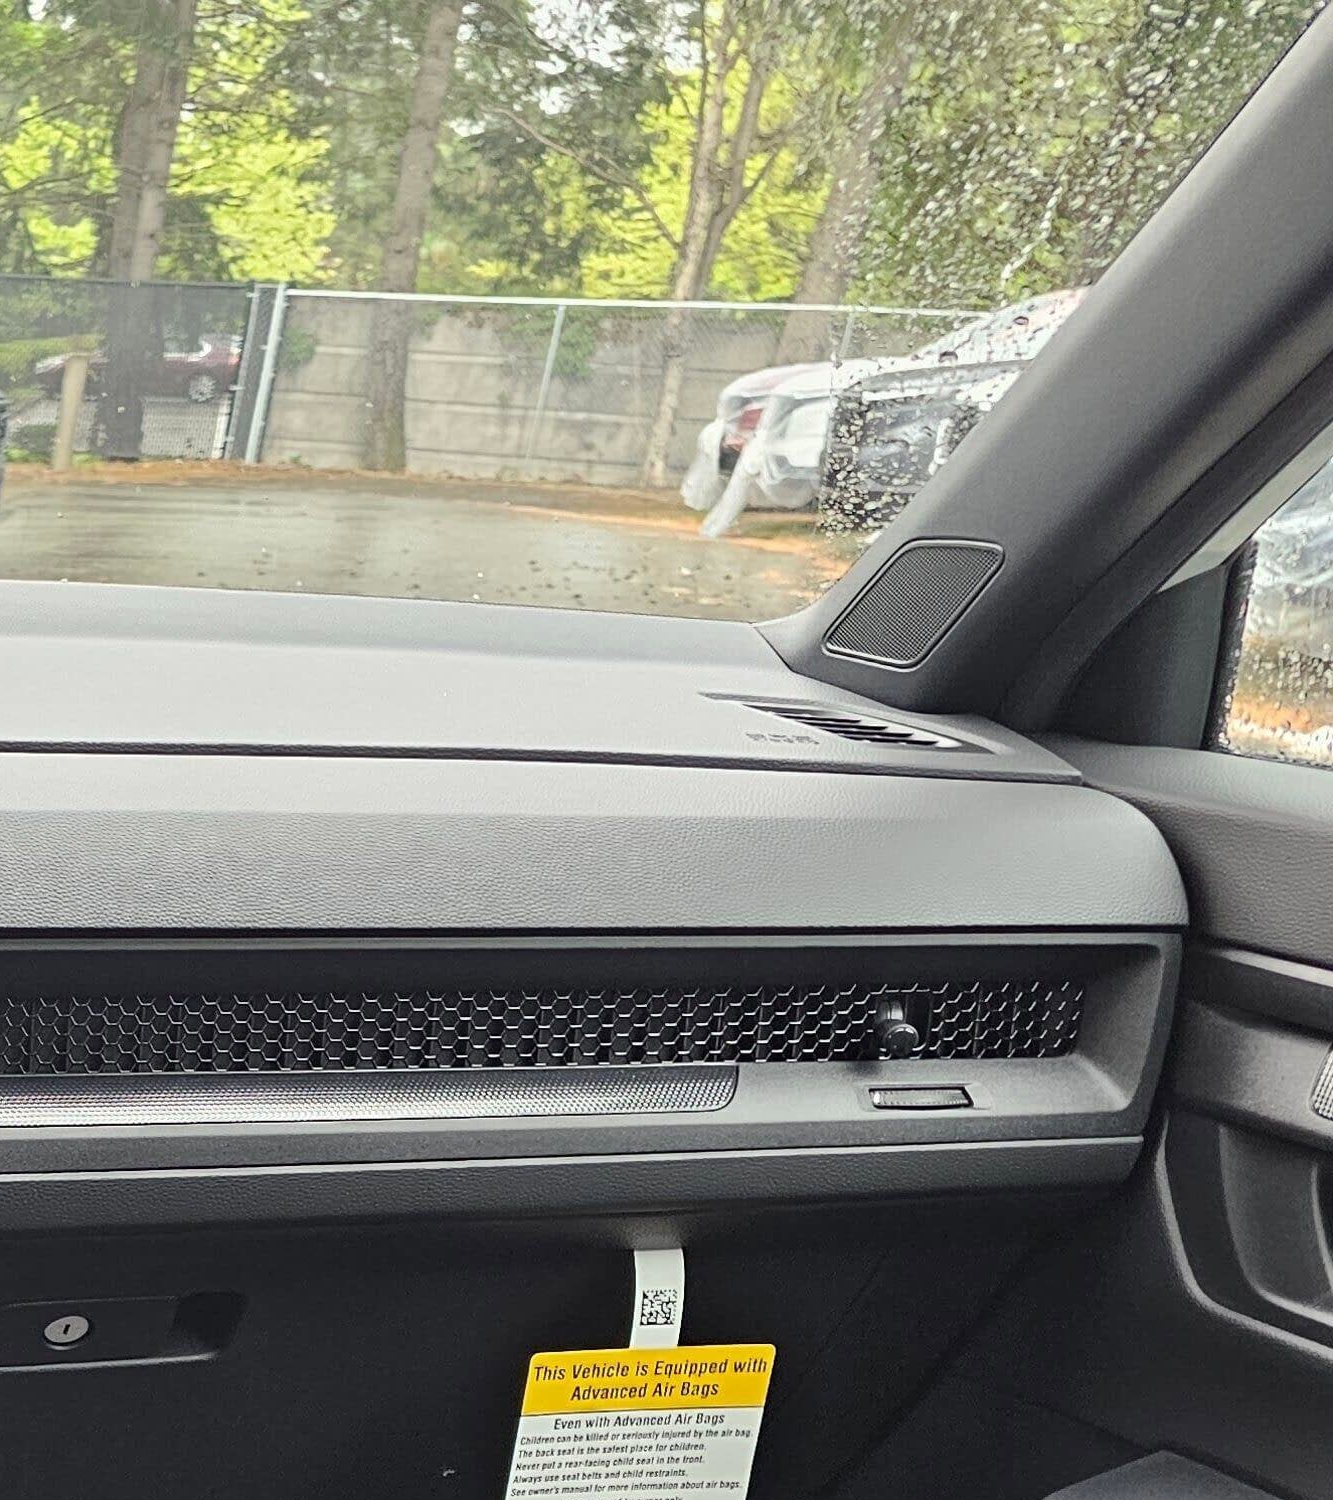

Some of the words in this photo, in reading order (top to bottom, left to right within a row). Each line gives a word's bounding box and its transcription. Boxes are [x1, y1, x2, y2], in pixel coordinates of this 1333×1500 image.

[534, 1366, 566, 1381] This
[572, 1362, 629, 1379] Vehicle
[635, 1361, 649, 1376] is
[654, 1359, 728, 1379] Equipped
[734, 1358, 767, 1373] with
[571, 1383, 648, 1401] Advanced
[652, 1382, 676, 1398] Air
[681, 1381, 719, 1399] Bags
[554, 1418, 582, 1430] Even
[586, 1416, 610, 1428] with
[613, 1414, 671, 1427] Advanced
[675, 1413, 692, 1425] Air
[696, 1412, 726, 1426] Bags
[520, 1436, 554, 1446] Children
[557, 1435, 571, 1443] can
[574, 1433, 583, 1442] be
[586, 1432, 609, 1441] killed
[611, 1433, 620, 1441] or
[622, 1431, 660, 1441] seriously
[662, 1430, 691, 1440] injured
[694, 1429, 703, 1439] by
[705, 1429, 719, 1437] the
[721, 1429, 733, 1437] air
[735, 1429, 753, 1438] bag.
[518, 1450, 533, 1458] The
[535, 1448, 554, 1457] back
[557, 1448, 575, 1456] seat
[577, 1447, 585, 1455] is
[587, 1446, 600, 1455] the
[602, 1445, 628, 1454] safest
[630, 1444, 653, 1455] place
[655, 1443, 667, 1451] for
[670, 1443, 706, 1451] children.
[516, 1462, 540, 1471] Never
[542, 1461, 555, 1471] put
[565, 1459, 610, 1469] rear-facing
[613, 1458, 634, 1466] child
[636, 1457, 654, 1465] seat
[667, 1456, 680, 1464] the
[683, 1455, 705, 1464] front.
[513, 1475, 542, 1484] Always
[561, 1472, 579, 1481] seat
[582, 1471, 602, 1480] belts
[605, 1470, 620, 1479] and
[622, 1469, 643, 1478] child
[645, 1469, 688, 1477] restraints.
[511, 1488, 525, 1497] See
[528, 1487, 559, 1496] owner's
[561, 1486, 592, 1494] manual
[594, 1484, 606, 1493] for
[608, 1484, 629, 1492] more
[631, 1482, 678, 1491] information
[680, 1481, 704, 1489] about
[720, 1480, 742, 1489] bags.
